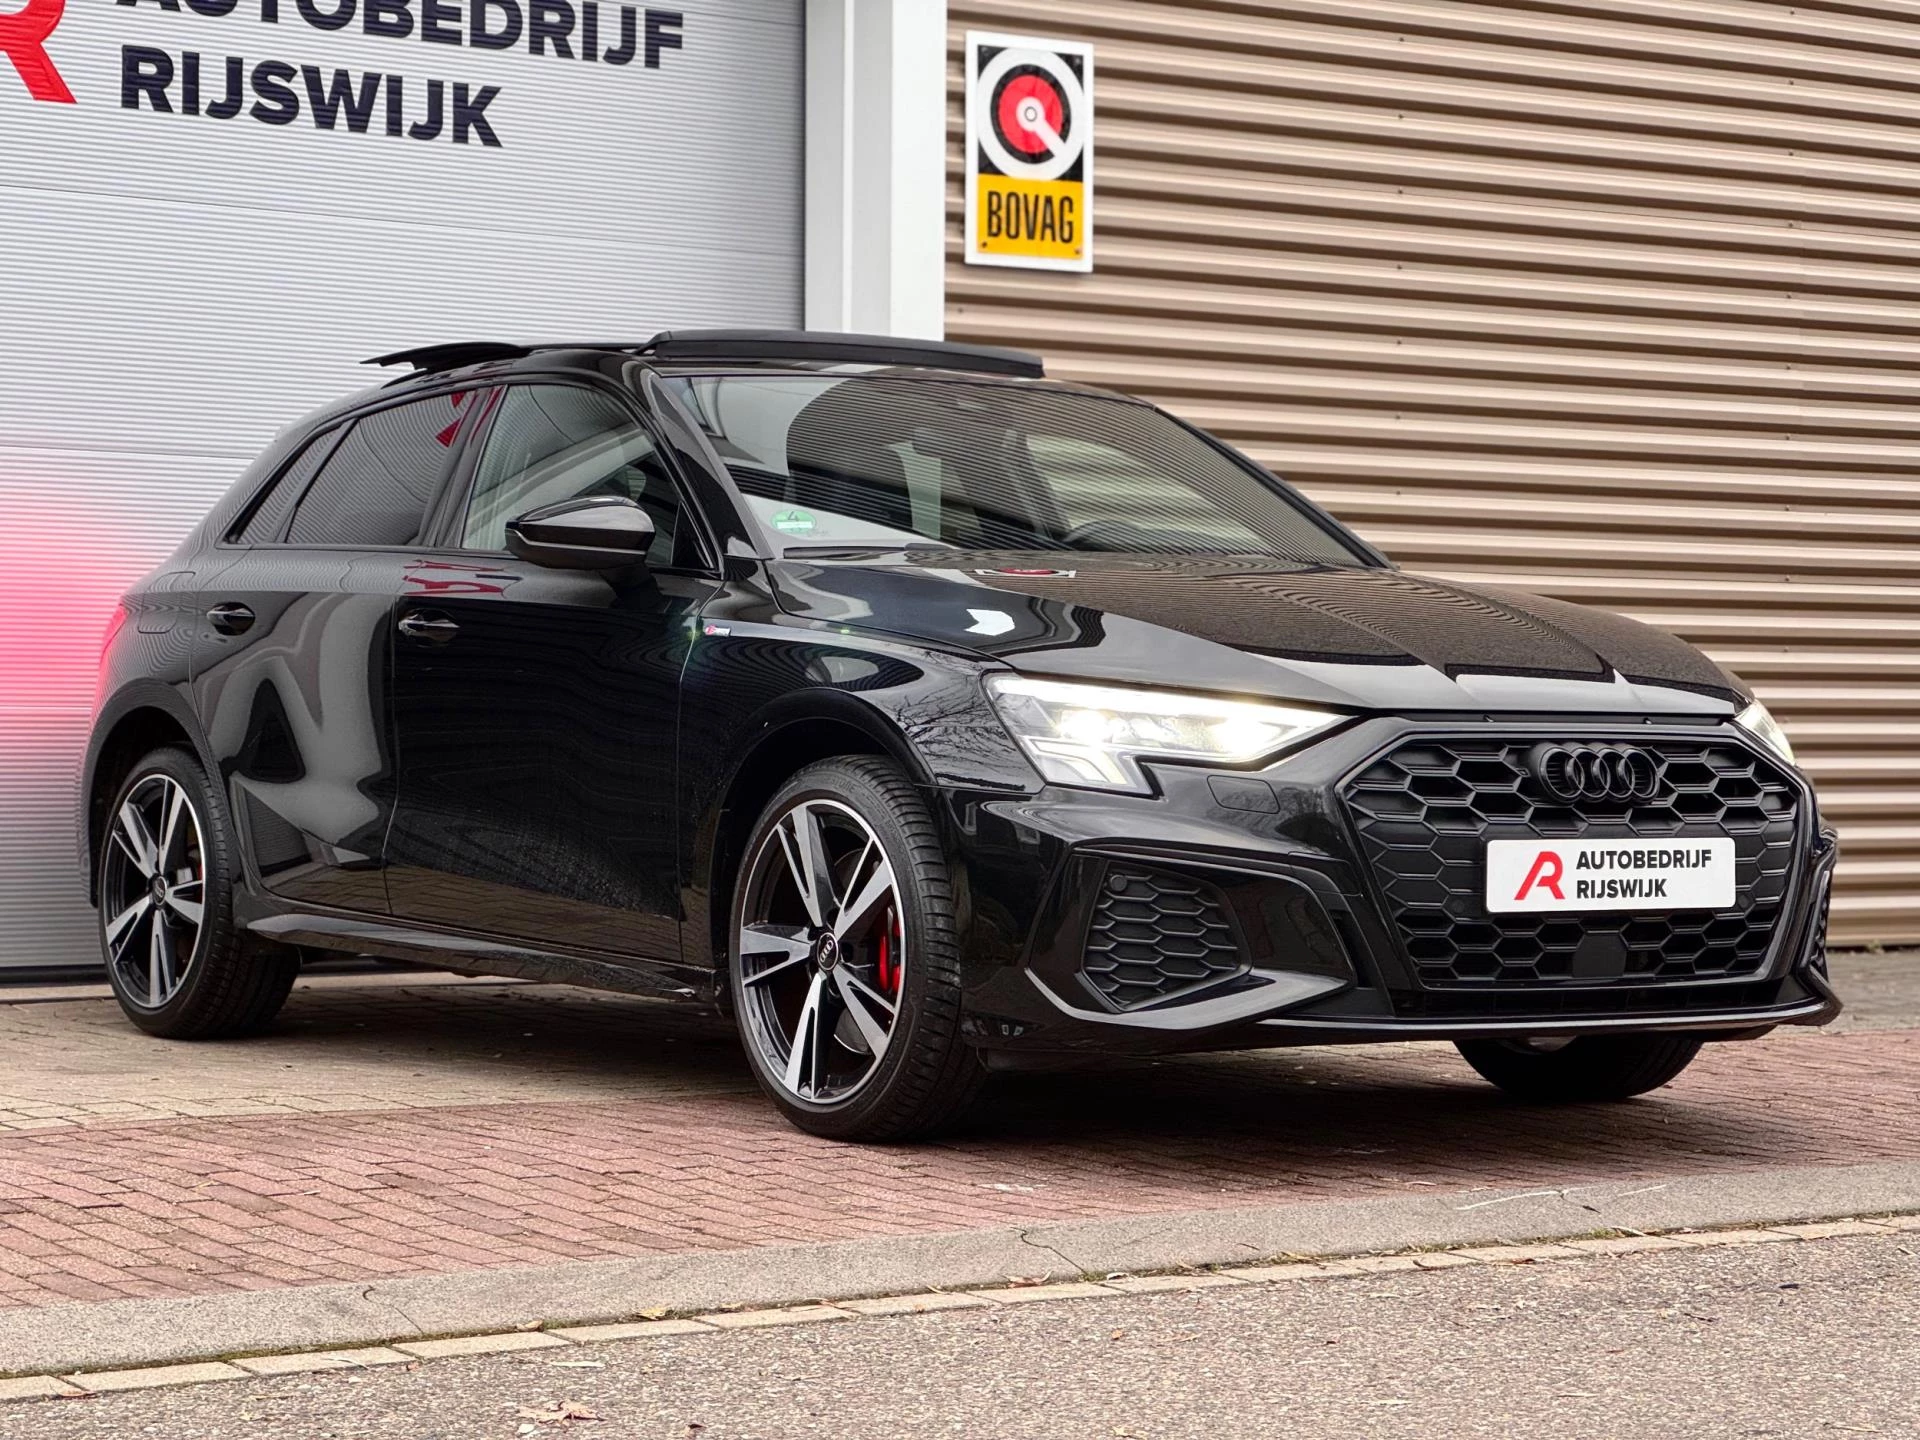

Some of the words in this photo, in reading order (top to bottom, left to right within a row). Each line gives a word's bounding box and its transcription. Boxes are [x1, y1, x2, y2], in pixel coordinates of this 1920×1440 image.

[115, 0, 684, 69] BEDRIJF
[121, 44, 504, 148] RIJSWIJK
[987, 190, 1074, 244] BOVAG
[1576, 849, 1712, 870] AUTOBEDRIJF
[1576, 878, 1668, 899] RIJSWIJK
